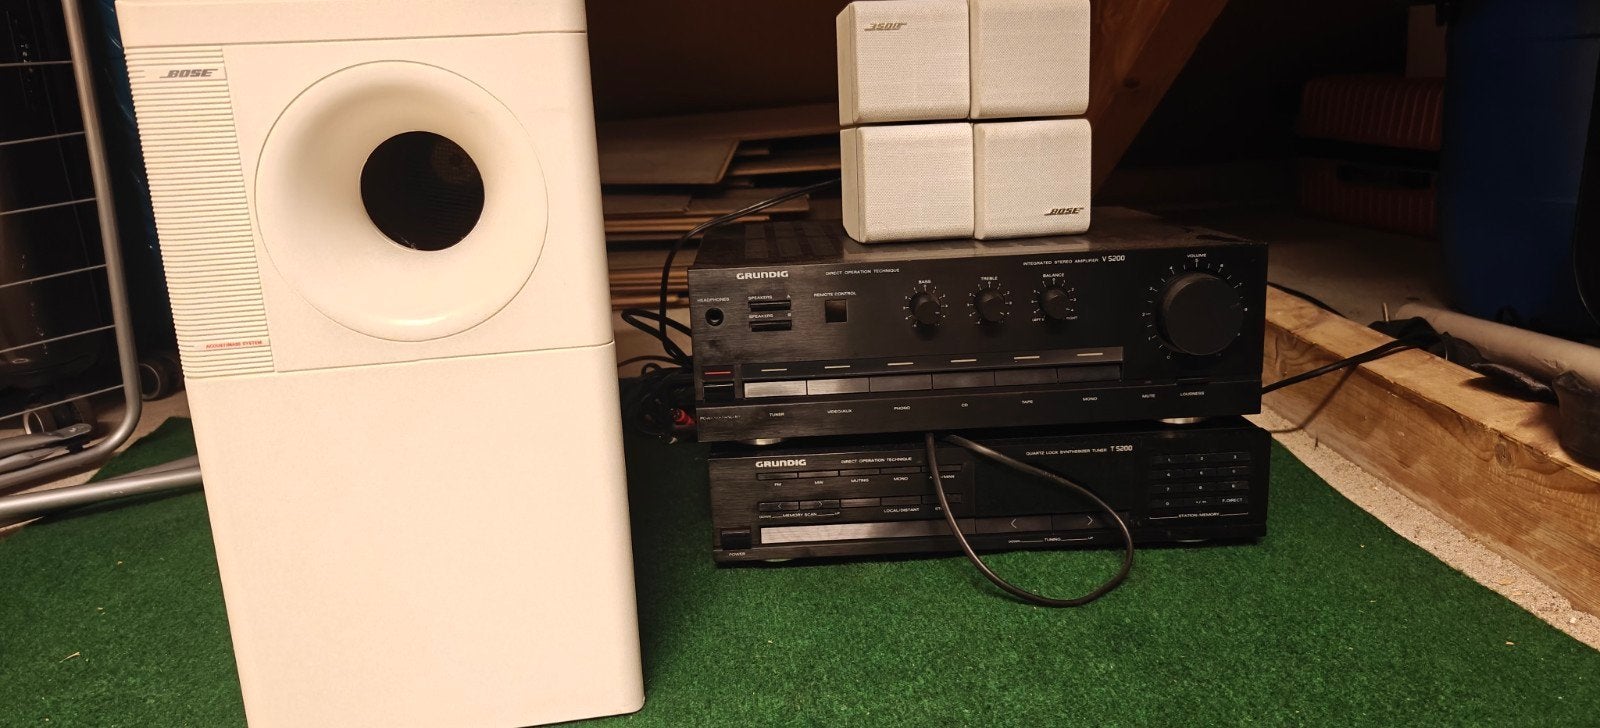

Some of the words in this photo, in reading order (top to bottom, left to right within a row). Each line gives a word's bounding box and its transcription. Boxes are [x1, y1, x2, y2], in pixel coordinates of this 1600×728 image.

[159, 68, 219, 78] BOSE
[1044, 207, 1084, 216] BOSE
[736, 270, 788, 280] GRUNDIG
[755, 459, 807, 468] GRUNDIG
